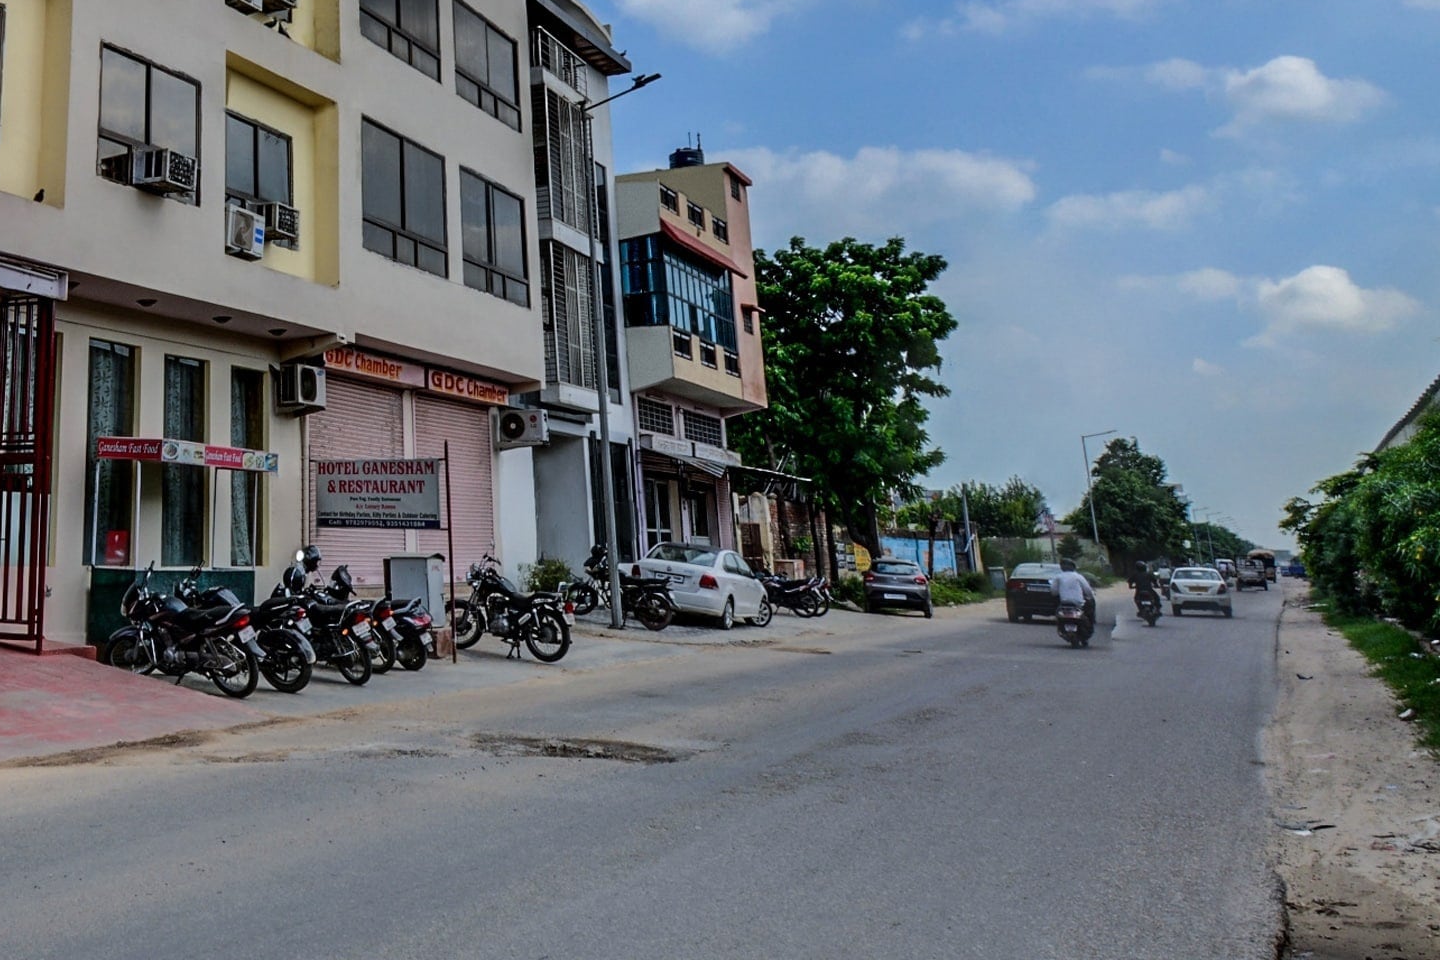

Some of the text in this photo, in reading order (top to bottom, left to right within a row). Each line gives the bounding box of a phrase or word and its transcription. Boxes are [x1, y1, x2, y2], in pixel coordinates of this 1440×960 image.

[325, 347, 403, 380] GDC Chamber
[431, 371, 508, 405] GDC Chamber
[128, 443, 142, 453] Fast
[143, 442, 161, 454] Food
[318, 460, 435, 475] HOTEL GANESHAM
[327, 480, 426, 494] & RESTAURANT
